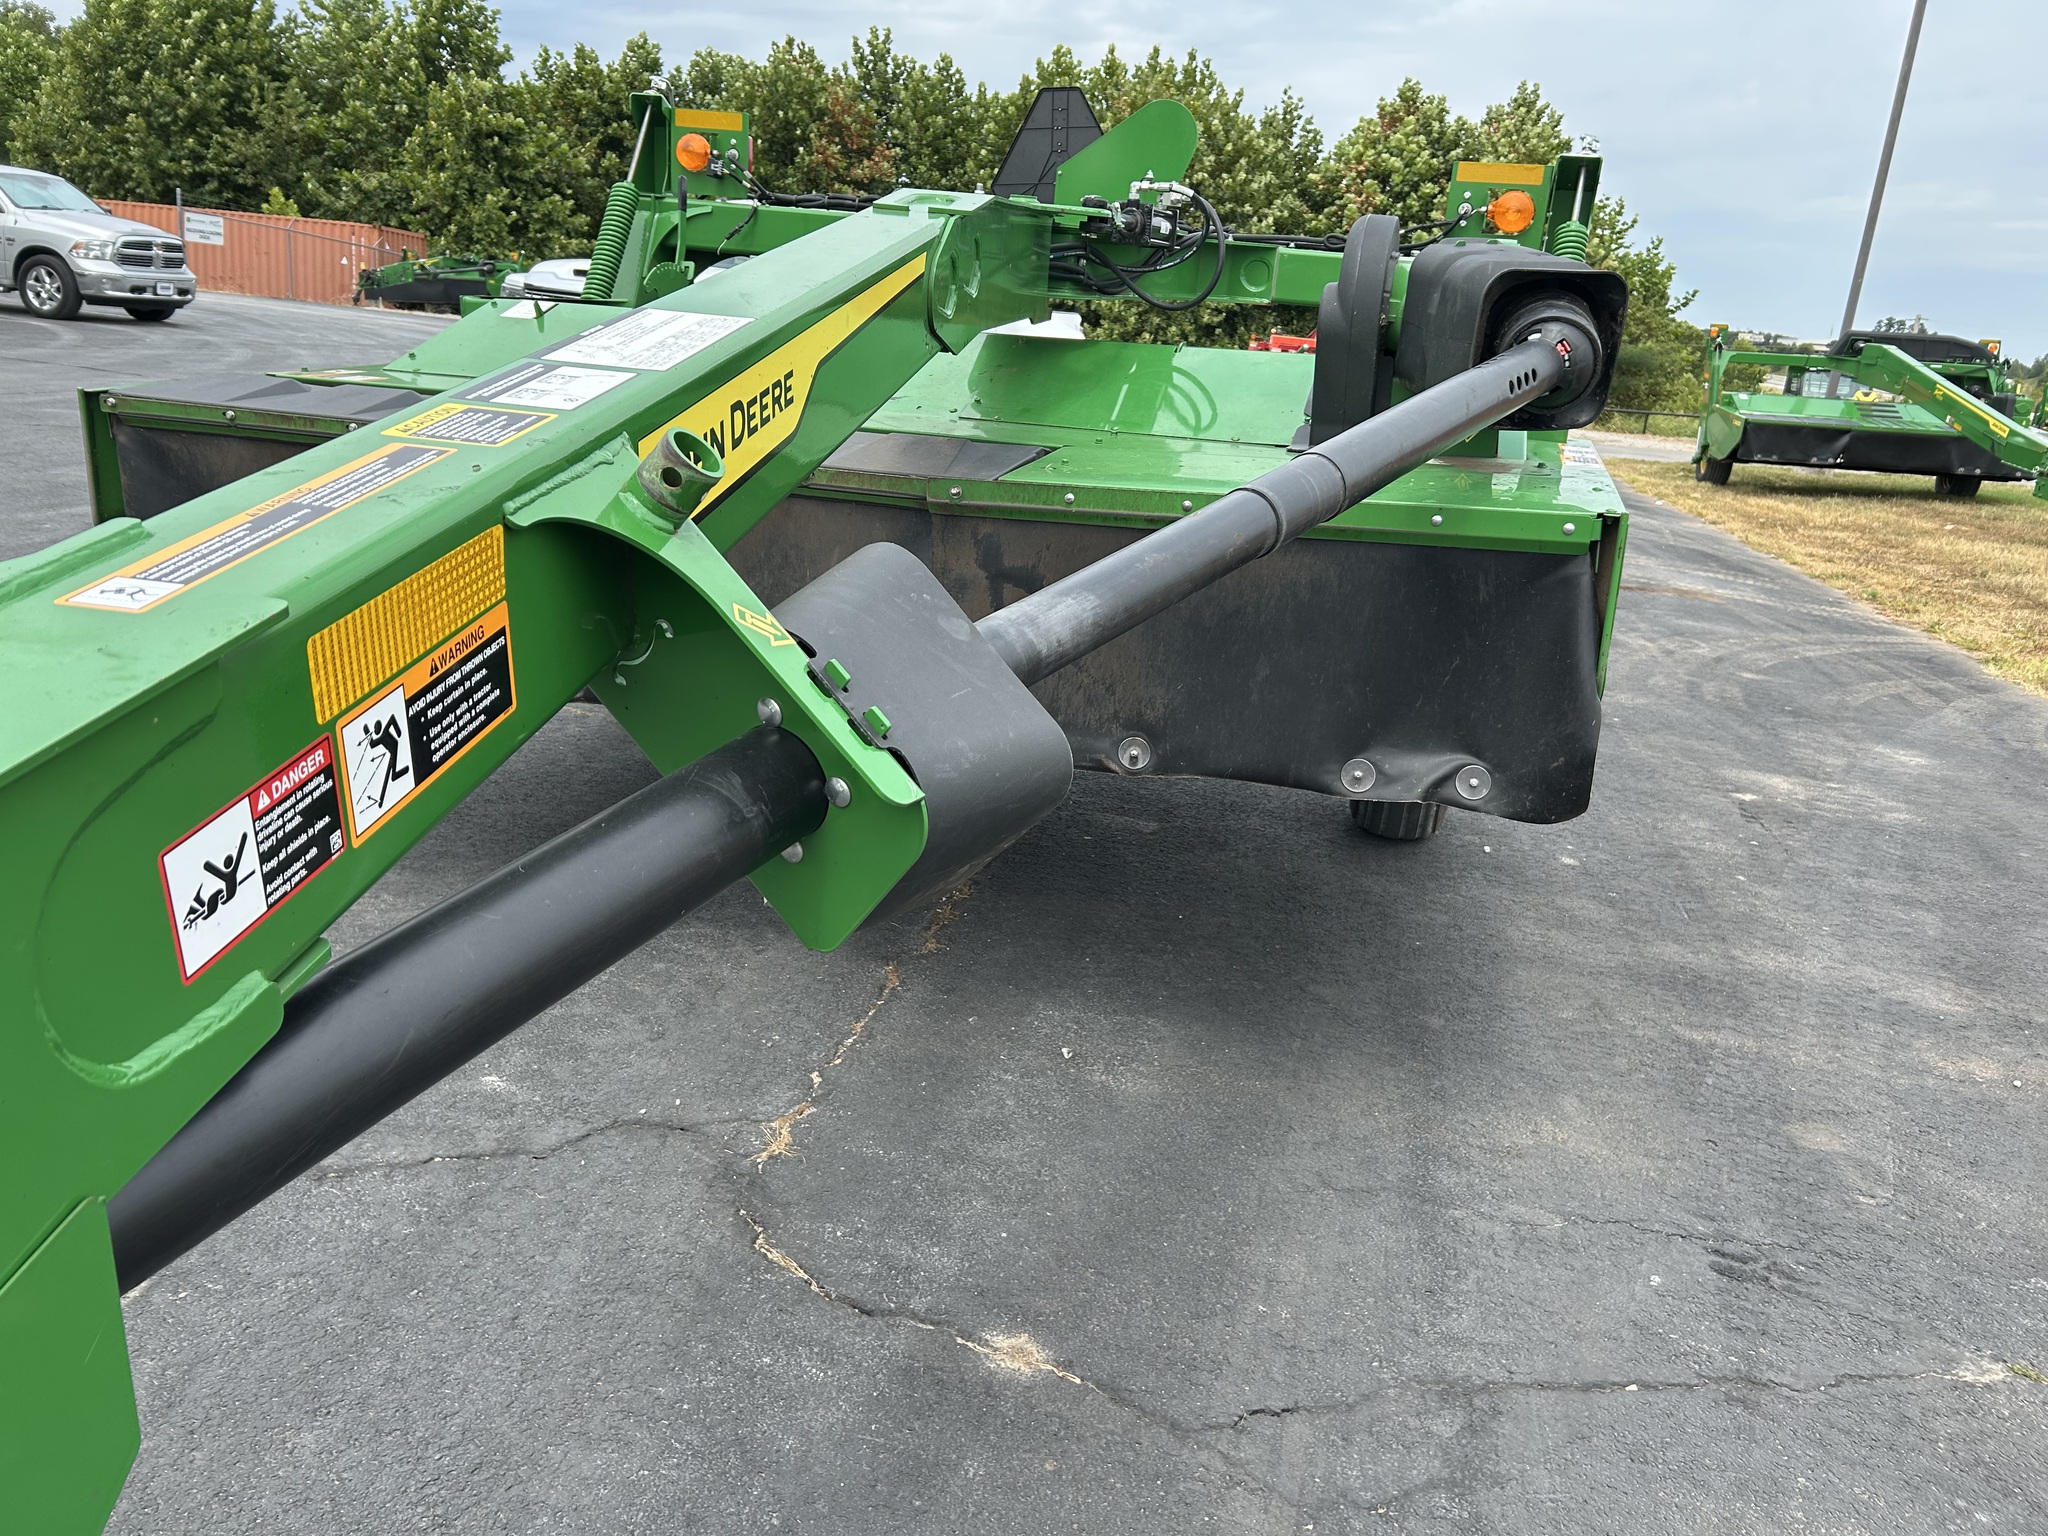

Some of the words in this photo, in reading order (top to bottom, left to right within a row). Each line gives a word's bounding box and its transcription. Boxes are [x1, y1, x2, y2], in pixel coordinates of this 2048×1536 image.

[403, 407, 458, 428] CAUTION
[730, 369, 794, 451] DEERE
[253, 487, 311, 514] WARNING
[438, 625, 485, 669] WARNING
[408, 697, 426, 717] AVOID
[426, 681, 445, 703] INJURY
[445, 669, 461, 688] FROM
[461, 652, 483, 675] THROWN
[483, 636, 505, 658] OBJECTS
[427, 702, 443, 719] Keep
[443, 685, 464, 706] curtain
[471, 668, 487, 686] place.
[429, 723, 441, 737] Use
[442, 712, 454, 727] only
[455, 701, 468, 716] with
[473, 682, 491, 701] tractor
[431, 721, 458, 750] equipped
[458, 712, 470, 727] with
[476, 688, 500, 712] complete
[432, 736, 457, 762] operator
[457, 714, 486, 740] enclosure.
[271, 749, 325, 800] DANGER
[255, 794, 296, 831] Entanglement
[302, 773, 324, 795] rotating
[257, 817, 283, 842] driveline
[283, 808, 295, 822] can
[295, 794, 312, 813] cause
[312, 778, 333, 799] serious
[258, 834, 276, 853] injury
[284, 814, 303, 833] death.
[262, 856, 278, 874] Keep
[278, 847, 286, 861] all
[287, 832, 307, 854] shields
[314, 815, 331, 834] place.
[266, 873, 283, 895] Avoid
[283, 856, 305, 880] contact
[305, 846, 317, 861] with
[267, 881, 291, 905] rotating
[291, 868, 307, 887] parts.
